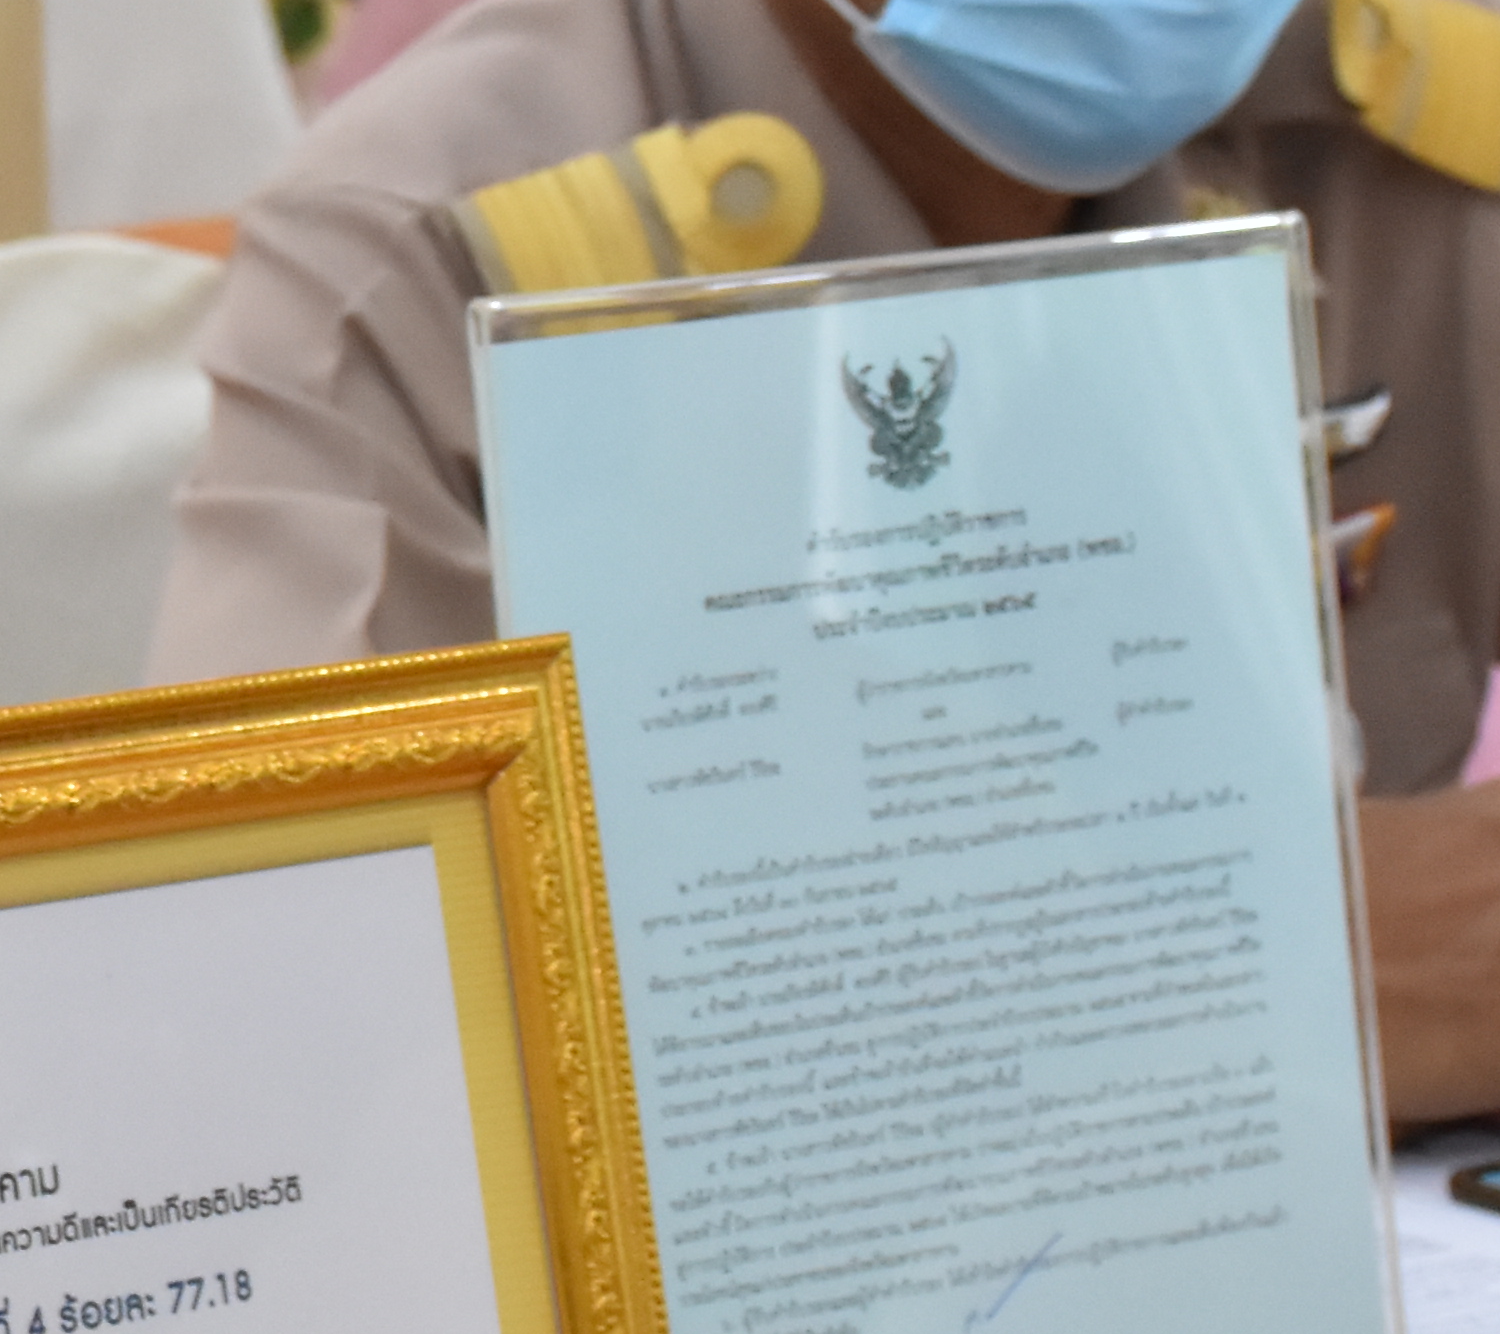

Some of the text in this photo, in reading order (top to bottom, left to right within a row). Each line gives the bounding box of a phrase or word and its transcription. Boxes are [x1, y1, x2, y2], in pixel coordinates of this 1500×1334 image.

[58, 1293, 156, 1334] ร้อยละ
[167, 1269, 252, 1314] 77.18
